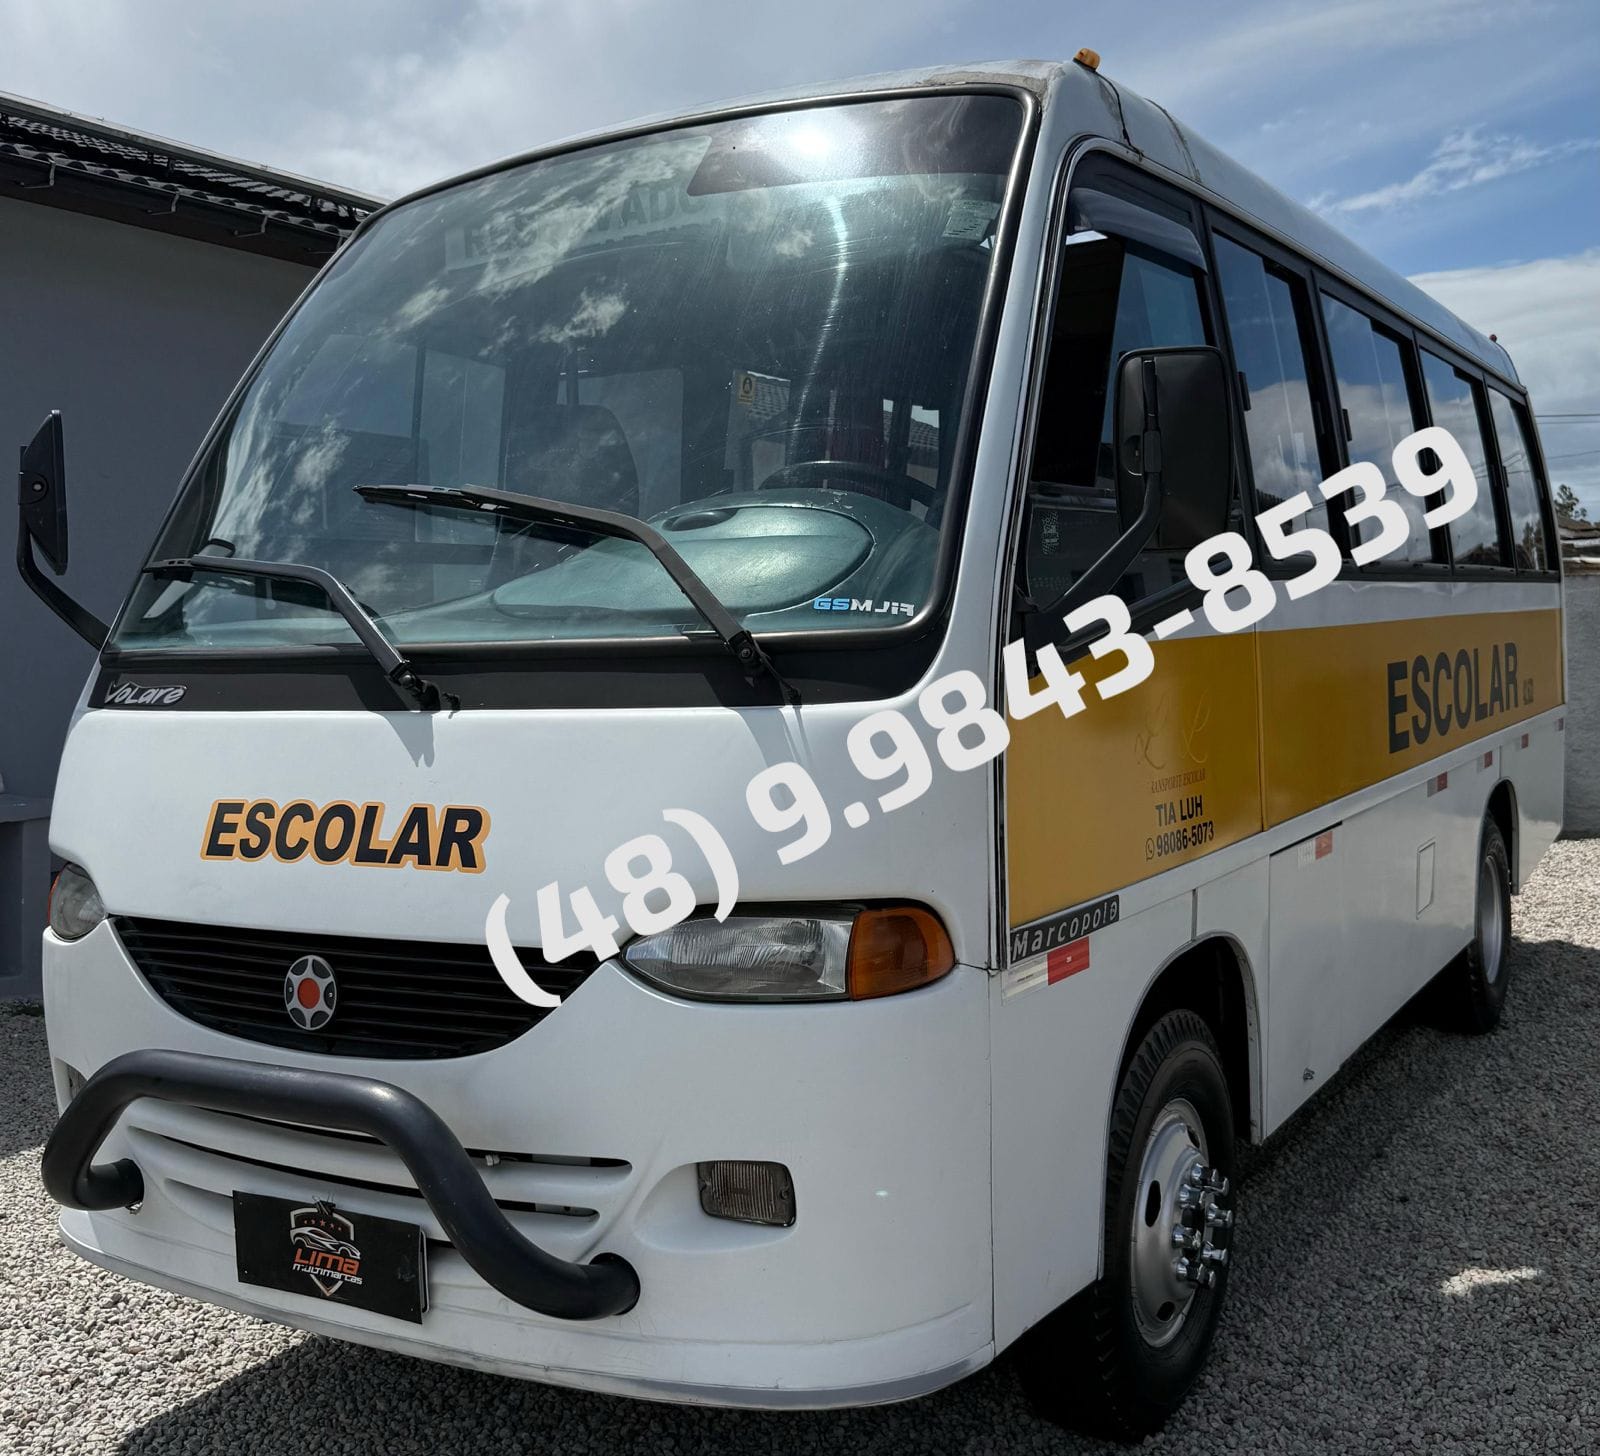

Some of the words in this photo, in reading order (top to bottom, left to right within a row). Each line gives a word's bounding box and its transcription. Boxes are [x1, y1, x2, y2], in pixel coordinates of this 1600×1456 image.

[1387, 642, 1518, 754] ESCOLAR
[206, 802, 483, 868] ESCOLAR
[1155, 801, 1177, 827] TIA
[1179, 795, 1203, 821] LUH
[1156, 821, 1214, 857] 98086-5073
[1012, 901, 1118, 961] Marcopolo
